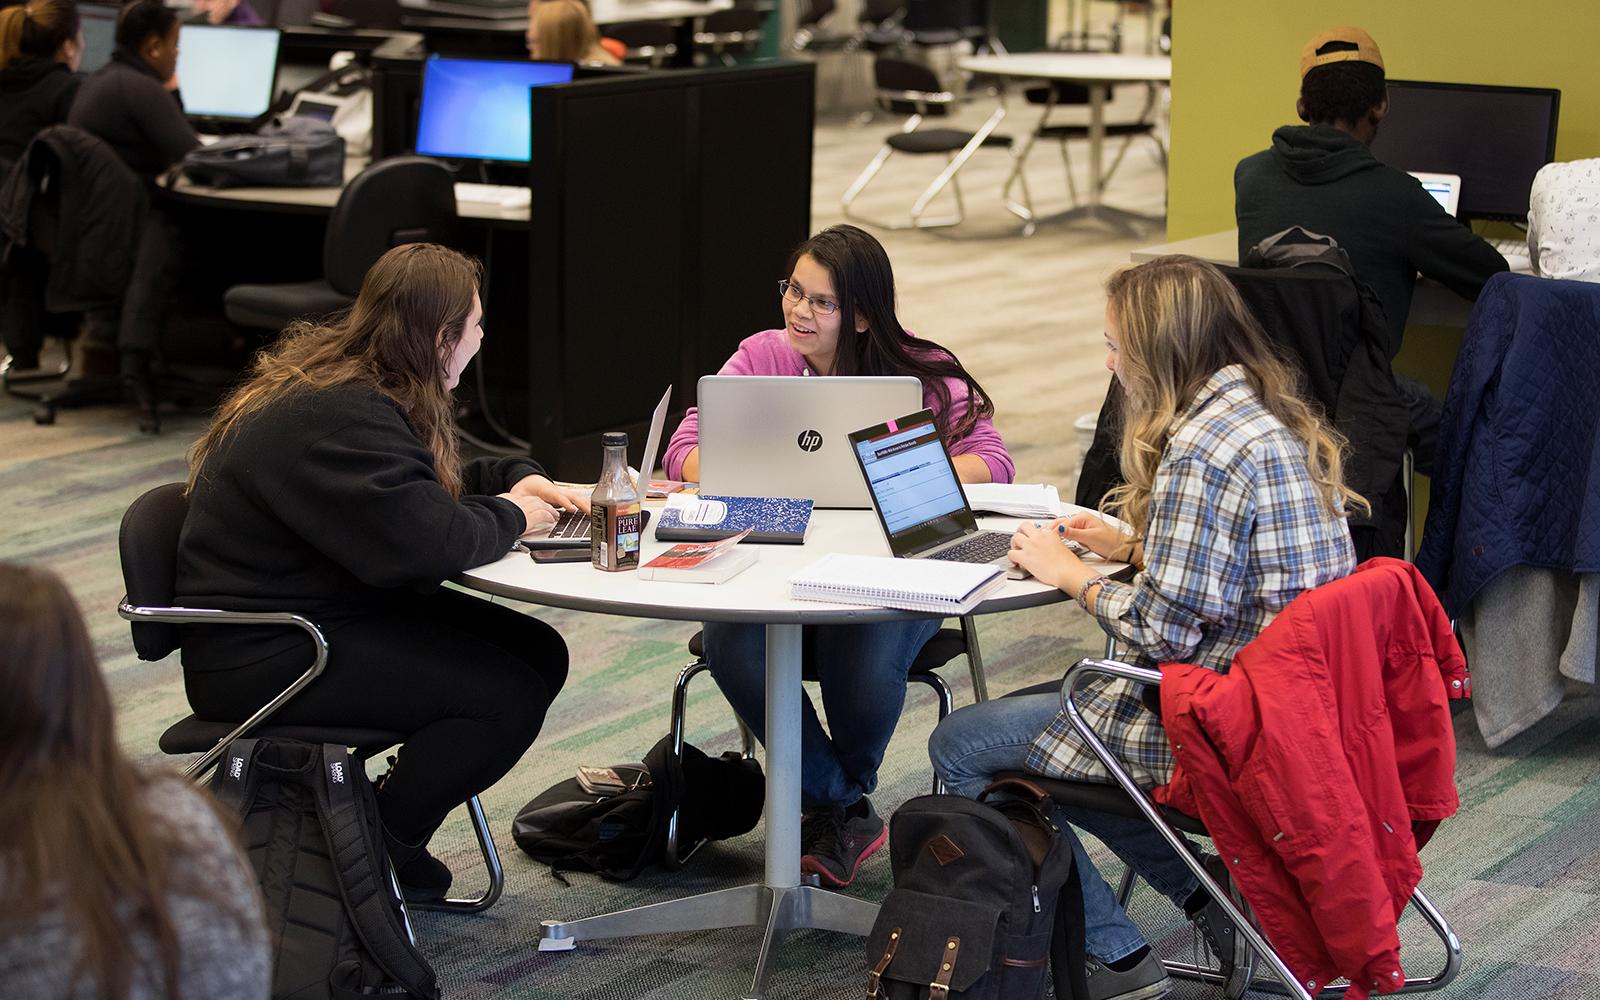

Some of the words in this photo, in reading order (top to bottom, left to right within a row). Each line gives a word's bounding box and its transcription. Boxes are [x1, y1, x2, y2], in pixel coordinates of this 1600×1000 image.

[801, 430, 820, 452] hp
[618, 517, 639, 527] PURE
[618, 525, 637, 534] LEAF
[234, 757, 244, 779] LOAD
[334, 762, 344, 783] LOAD
